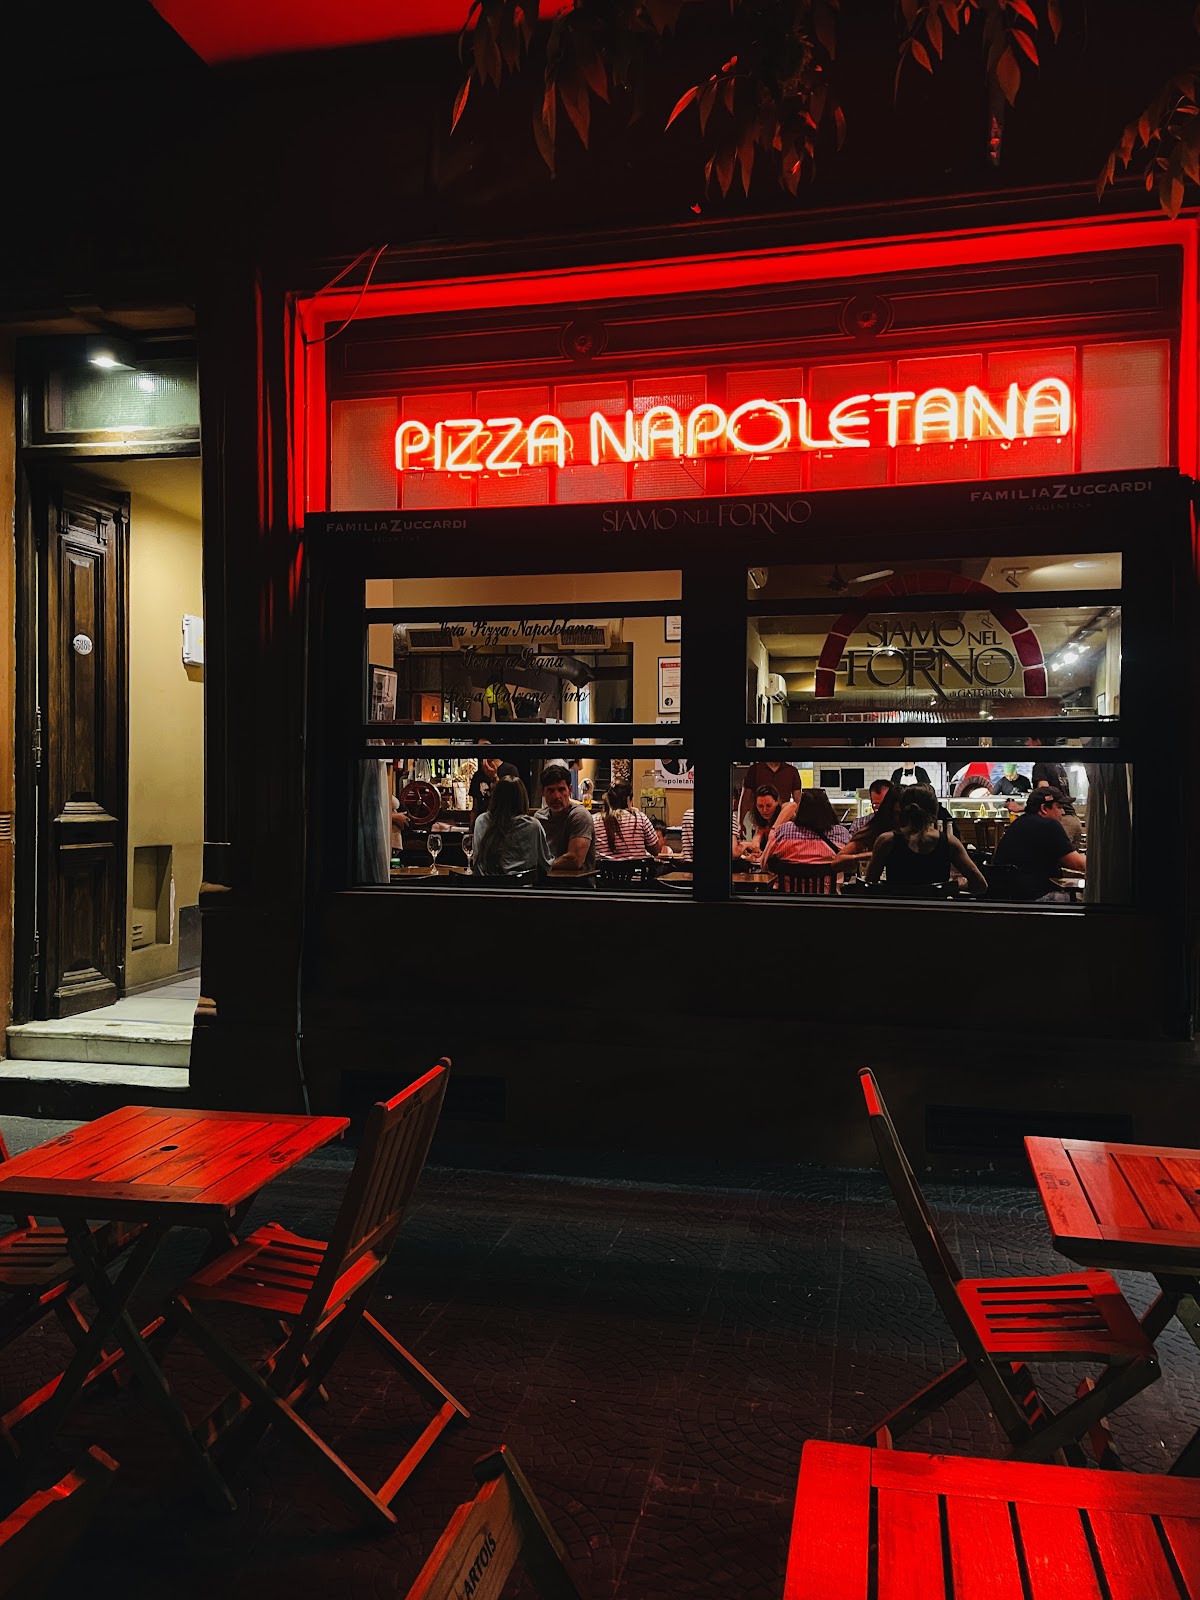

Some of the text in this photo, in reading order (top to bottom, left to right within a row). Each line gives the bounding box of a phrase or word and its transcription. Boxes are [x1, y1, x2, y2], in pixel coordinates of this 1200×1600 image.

[395, 377, 1071, 471] PIZZA NAPOLETANA
[602, 508, 677, 533] SIAMO
[718, 500, 812, 535] FORNO
[470, 620, 511, 645] Pizza
[512, 618, 599, 643] Napoletana
[866, 619, 1003, 648] SIAMO NEL
[846, 647, 1016, 701] FORNO
[463, 1532, 497, 1600] ARTOIS
